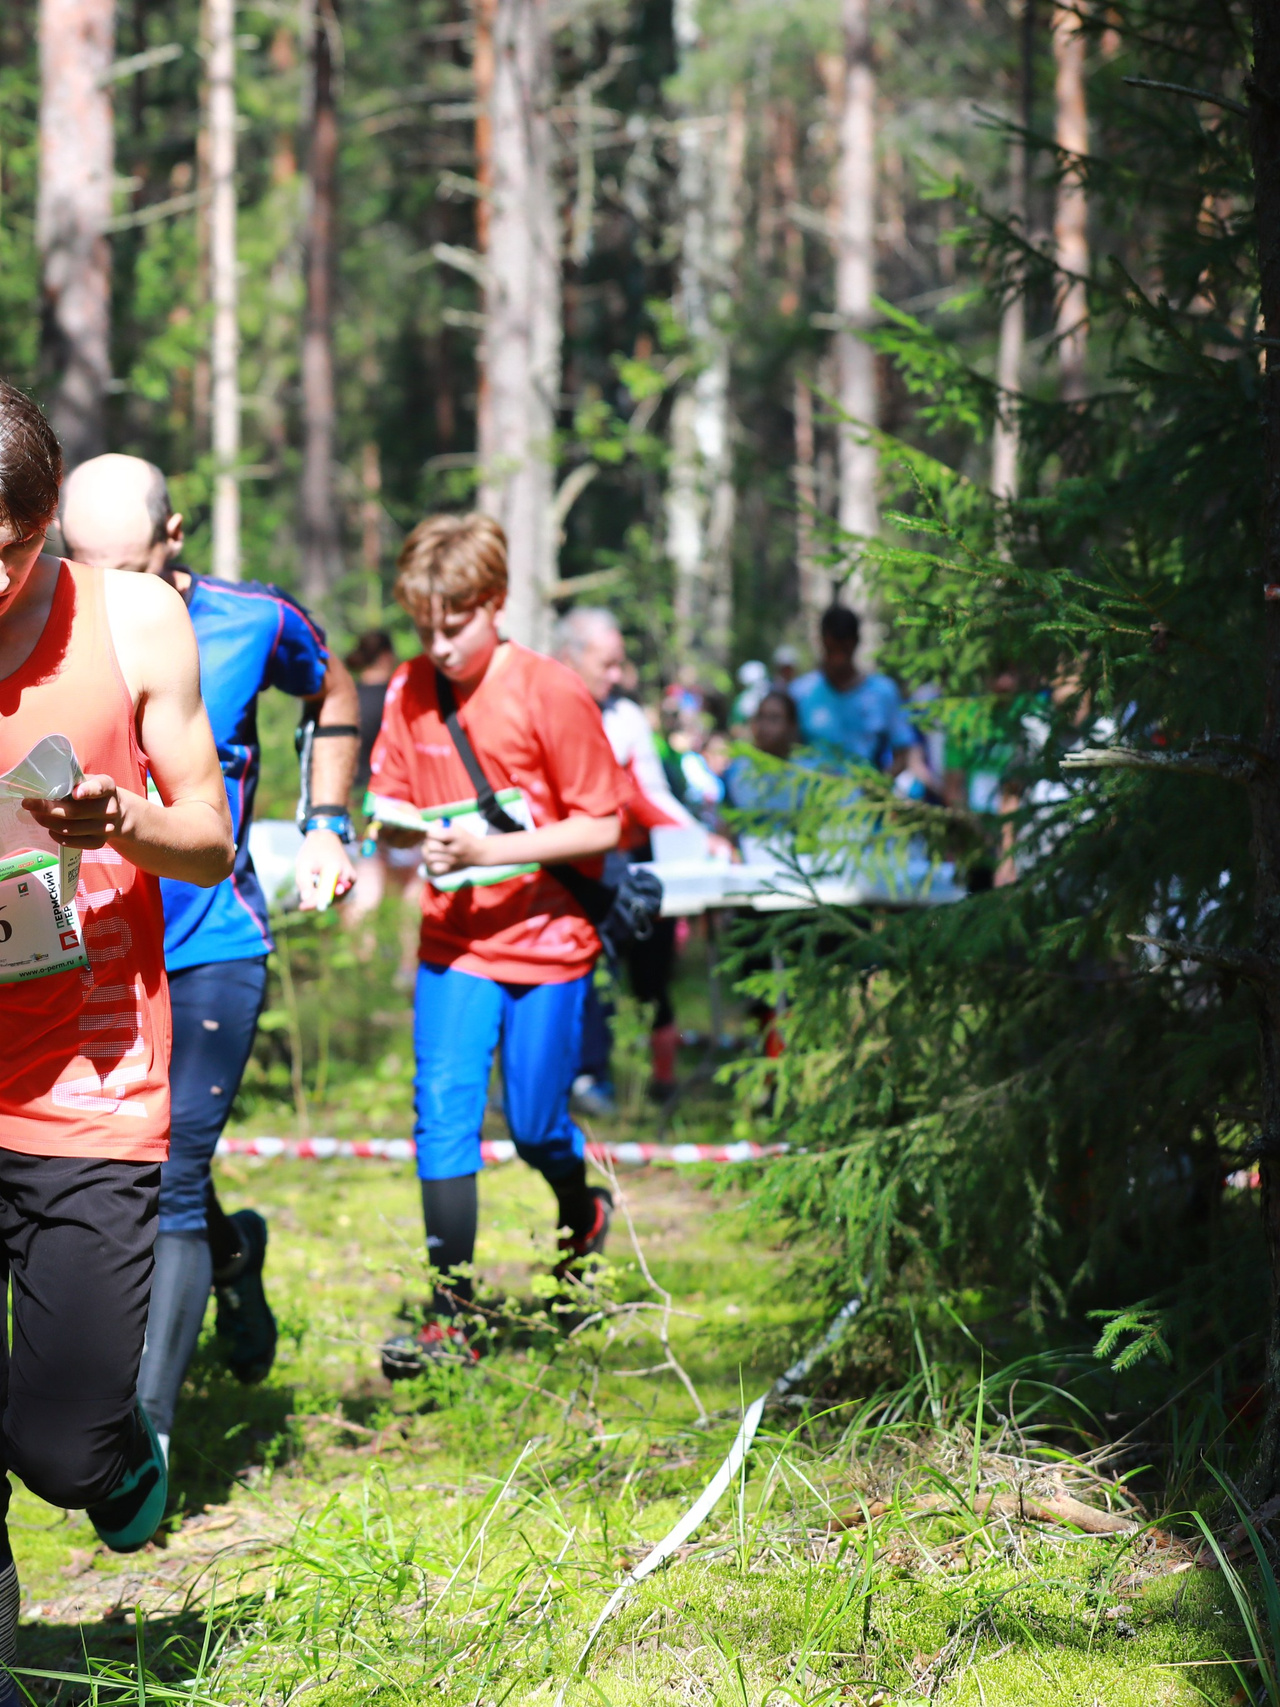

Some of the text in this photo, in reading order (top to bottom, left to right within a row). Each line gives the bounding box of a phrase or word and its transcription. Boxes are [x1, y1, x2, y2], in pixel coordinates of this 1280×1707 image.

[43, 871, 64, 929] ПЕРМСКИЙ
[62, 905, 75, 926] ПЕР
[19, 959, 75, 978] www.o-perm.ru
